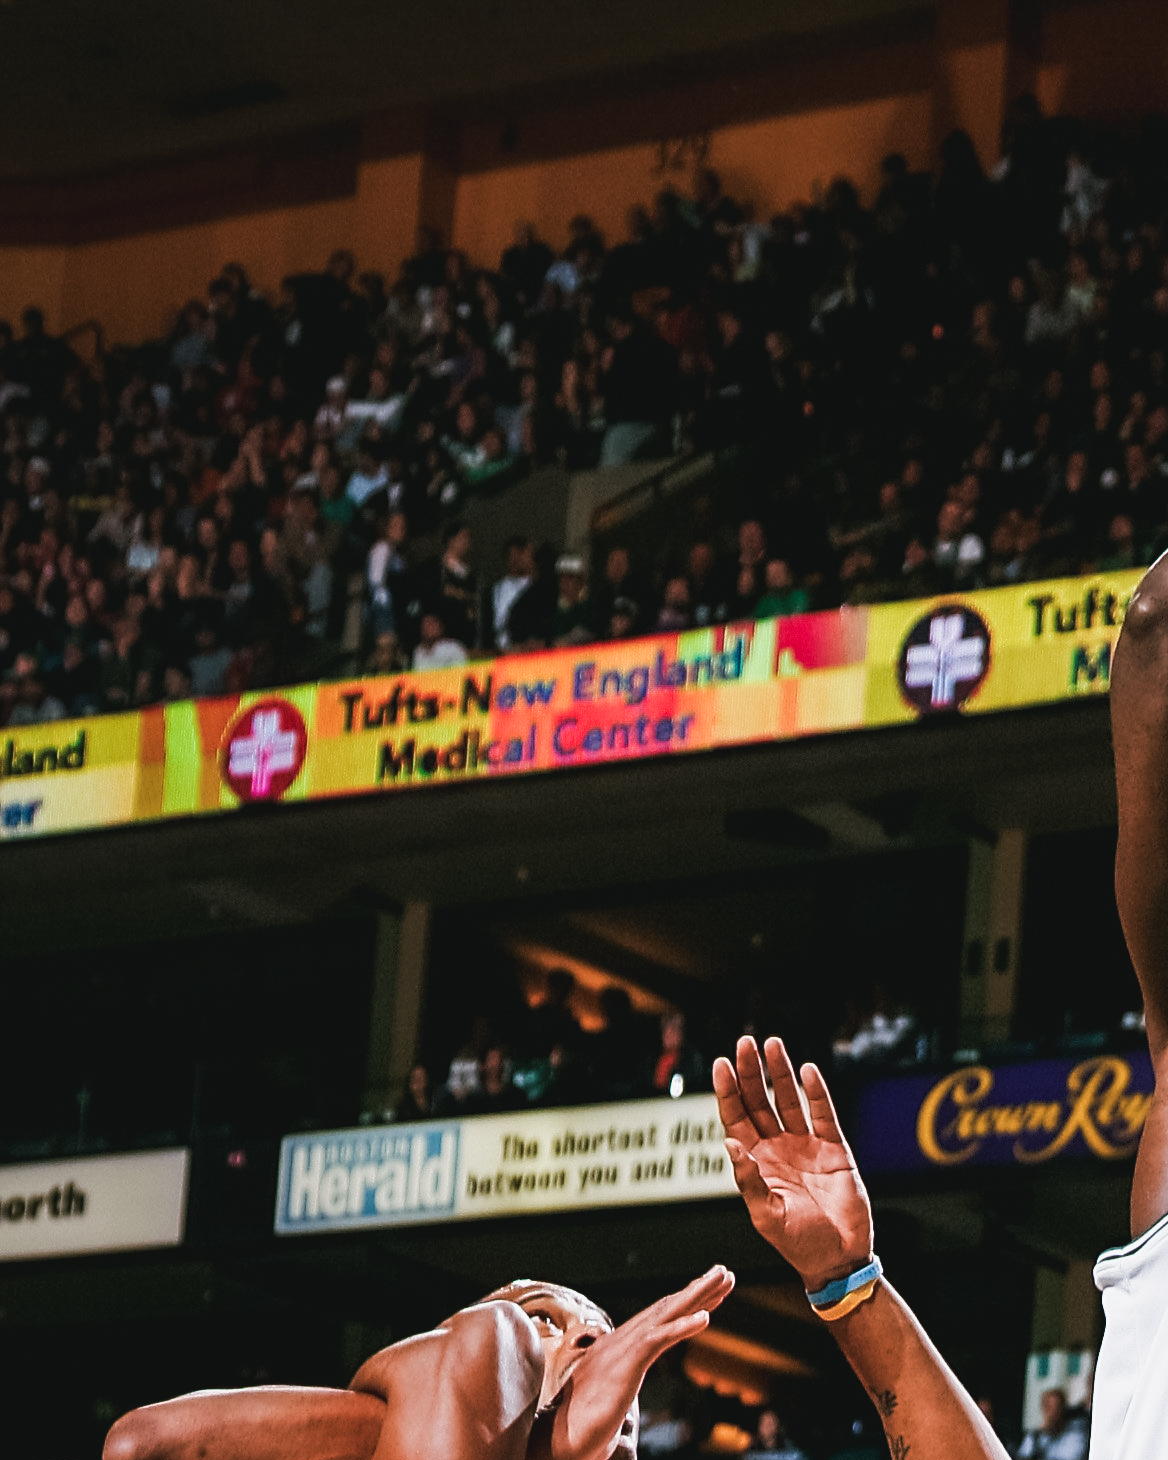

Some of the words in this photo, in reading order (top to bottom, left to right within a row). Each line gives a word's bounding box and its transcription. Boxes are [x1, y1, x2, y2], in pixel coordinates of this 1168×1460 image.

[340, 670, 556, 734] Tufts-New
[572, 636, 742, 704] England
[0, 728, 86, 776] land
[378, 724, 538, 784] Medical
[552, 710, 694, 758] Center
[503, 1134, 538, 1162] The
[553, 1120, 656, 1158] shortest
[670, 1116, 726, 1146] dist
[916, 1064, 1061, 1165] Crown
[288, 1128, 455, 1218] Herald
[466, 1168, 566, 1197] between
[578, 1164, 618, 1193] you
[633, 1153, 674, 1182] and
[686, 1150, 724, 1177] the
